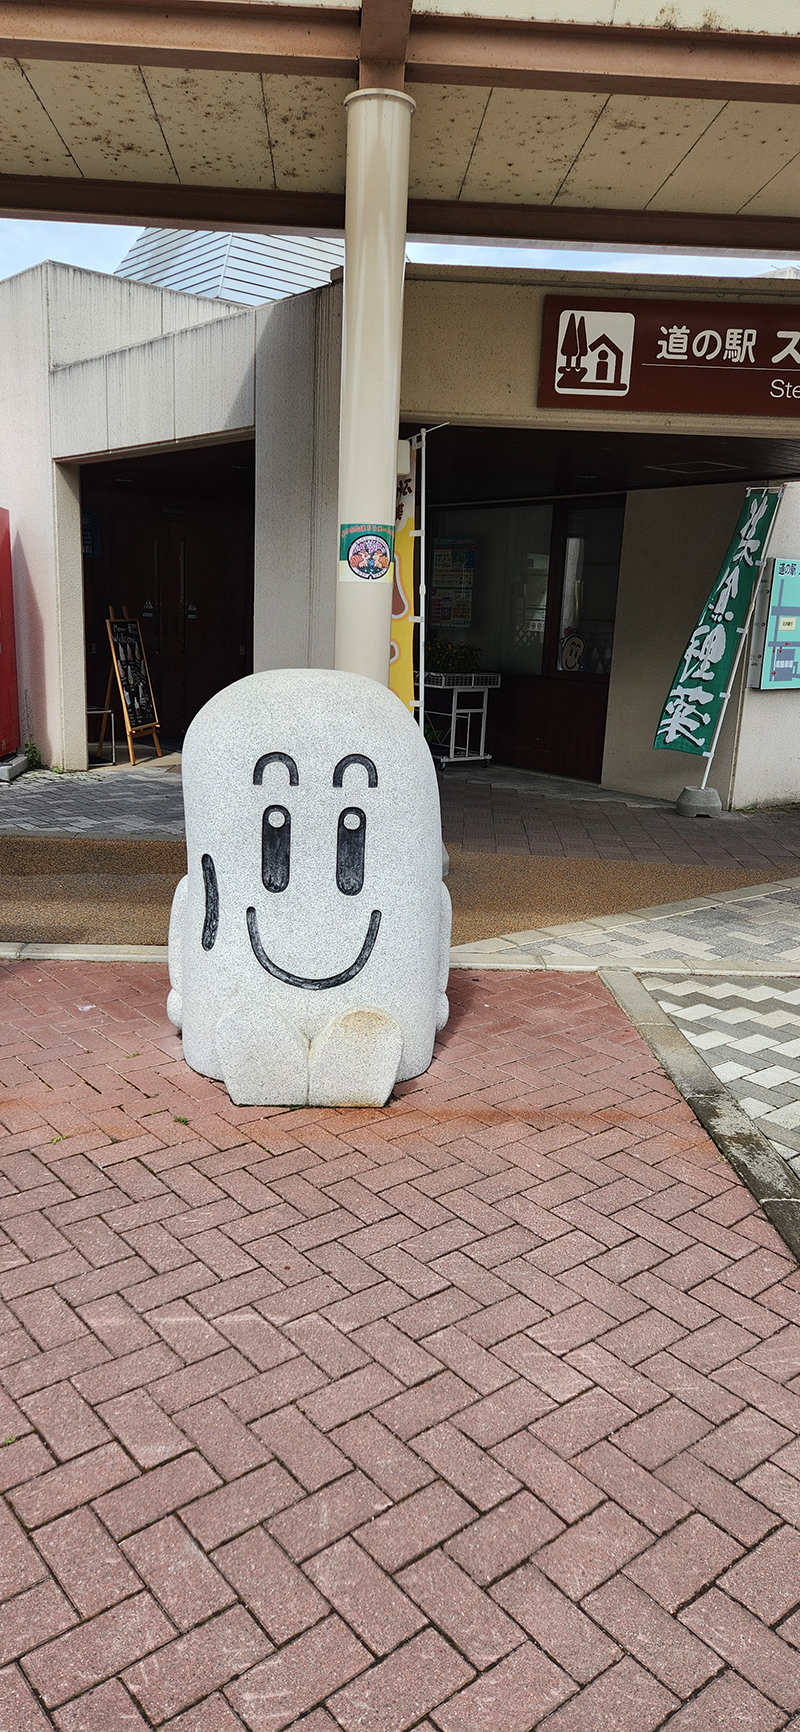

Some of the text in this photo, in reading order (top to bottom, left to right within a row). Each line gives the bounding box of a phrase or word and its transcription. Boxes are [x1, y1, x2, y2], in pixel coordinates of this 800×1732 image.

[656, 325, 800, 364] 道の駅 ス
[769, 378, 800, 398] Ste
[779, 563, 797, 576] 道の駅
